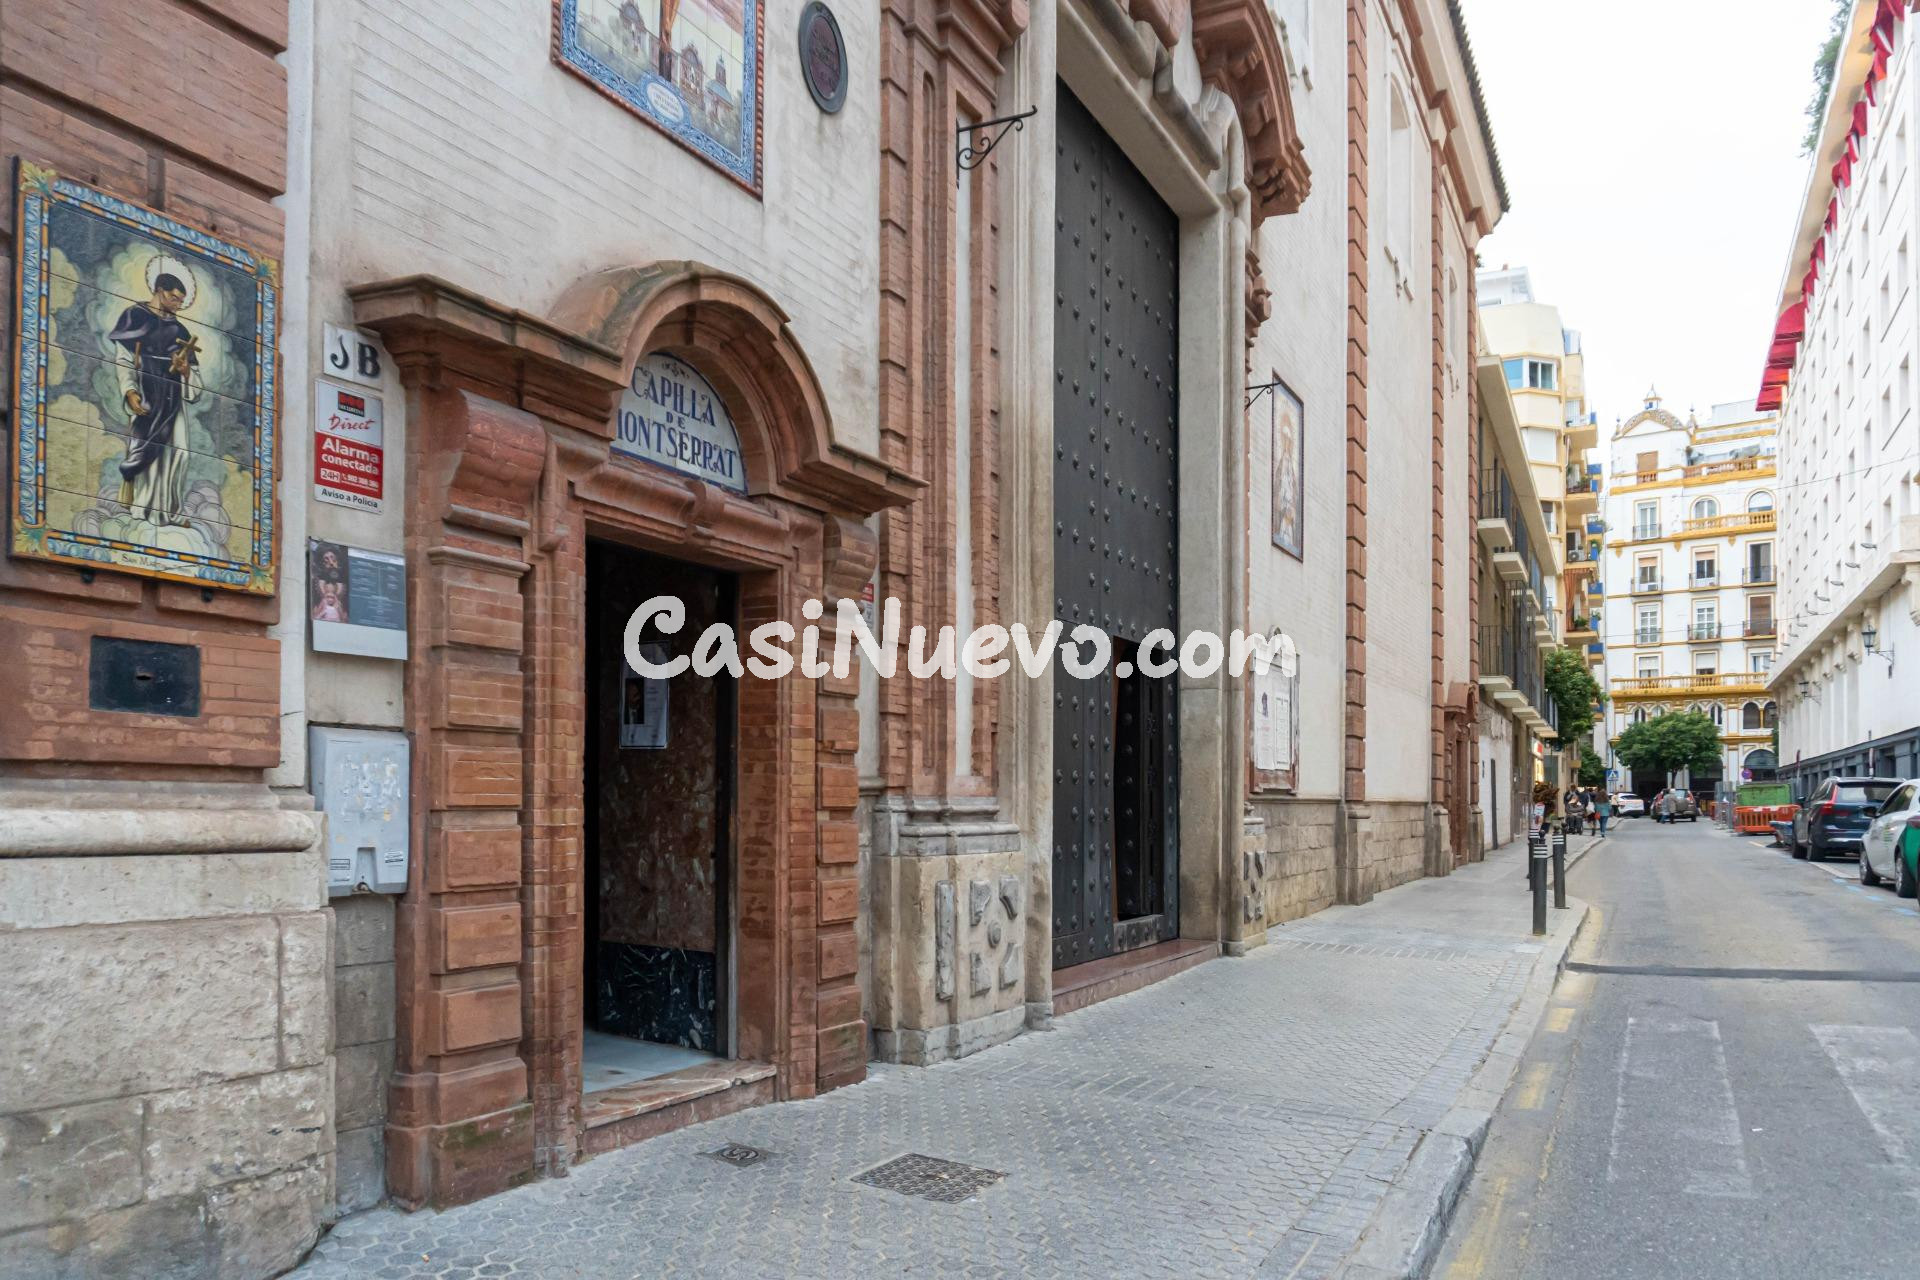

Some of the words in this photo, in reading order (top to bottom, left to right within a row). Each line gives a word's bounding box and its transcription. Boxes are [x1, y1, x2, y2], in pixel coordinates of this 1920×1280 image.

[631, 366, 716, 427] CAPILLA
[328, 413, 375, 430] Direct
[666, 411, 686, 430] DE
[322, 437, 379, 463] Alarma
[617, 408, 737, 478] ONTSERRAT
[321, 453, 379, 475] conectada
[322, 469, 339, 481] 24H
[321, 488, 345, 500] Aviso
